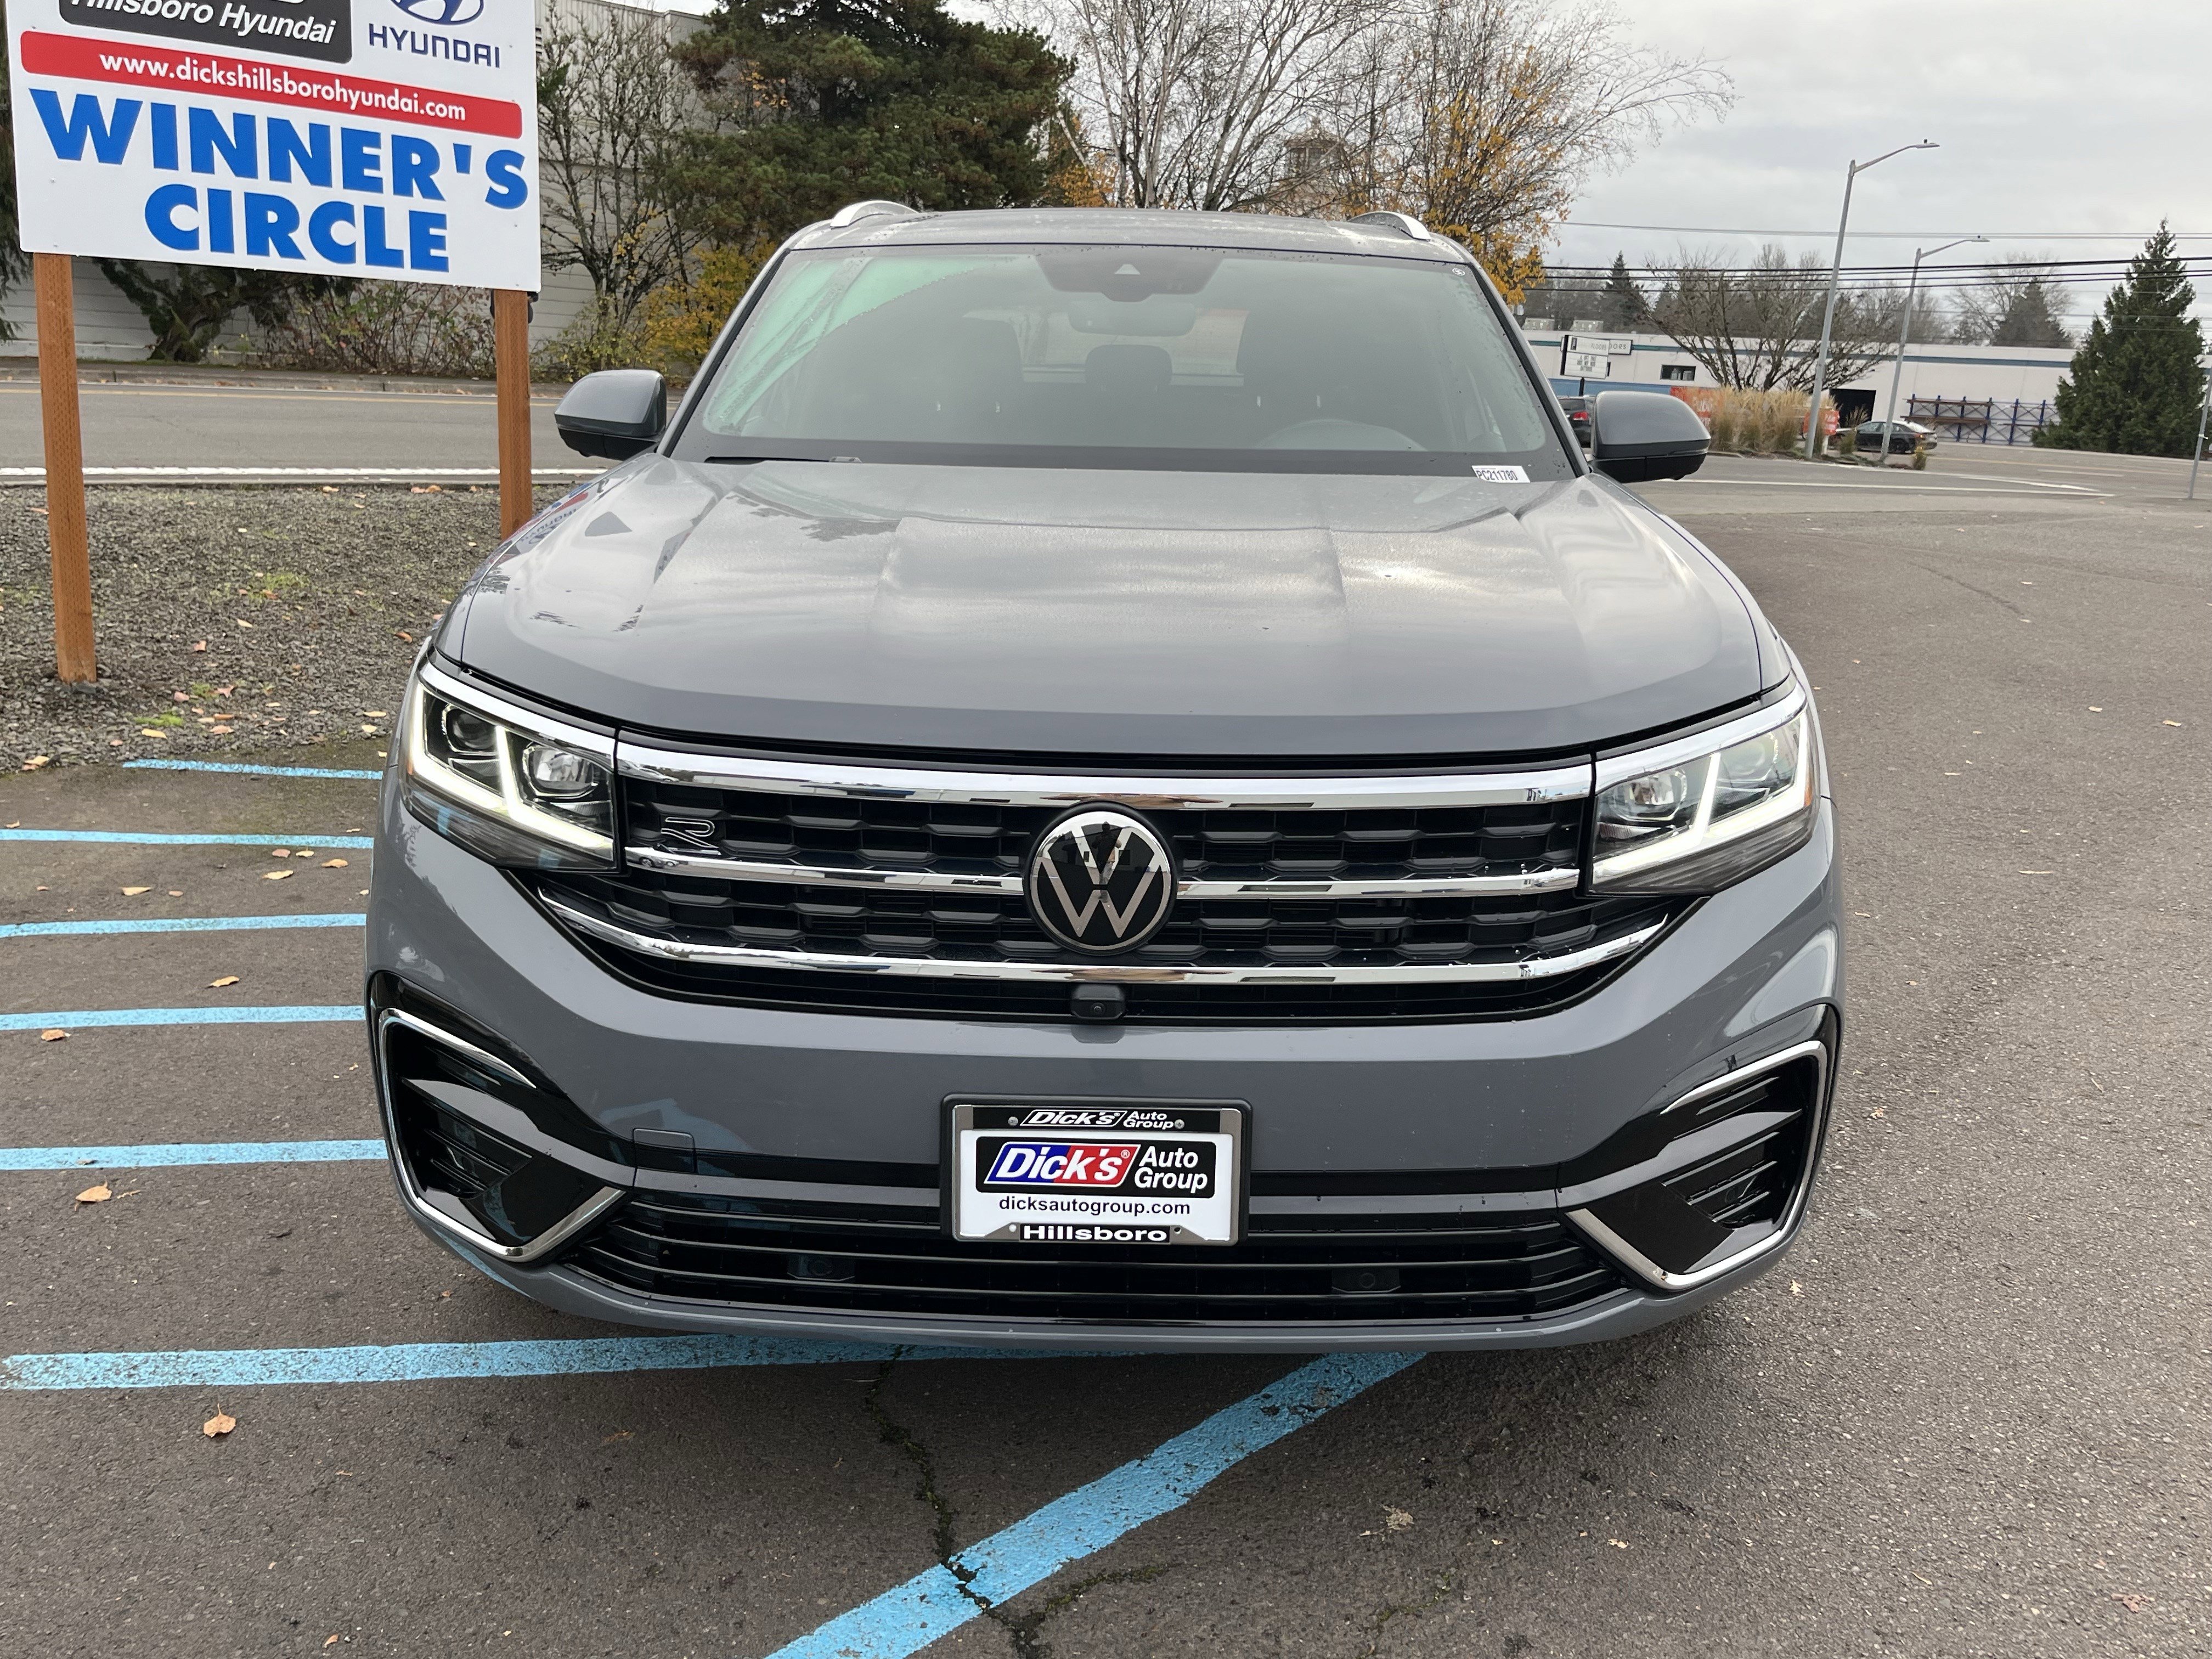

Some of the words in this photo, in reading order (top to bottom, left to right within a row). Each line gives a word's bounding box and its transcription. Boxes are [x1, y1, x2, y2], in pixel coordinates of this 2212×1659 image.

[71, 0, 214, 24] sboro
[219, 2, 336, 44] Hyundai
[369, 24, 501, 68] HYUNDAI
[99, 51, 466, 122] www.dickshillsborohyundai.com
[29, 88, 528, 210] WINNER'S
[144, 184, 449, 273] CIRCLE
[1475, 470, 1518, 481] PC211780
[1123, 1119, 1174, 1130] Group
[1126, 1111, 1167, 1120] Auto
[1139, 1146, 1198, 1169] Auto
[1134, 1166, 1208, 1194] Group
[999, 1196, 1190, 1216] dicksautogroup.com
[1023, 1226, 1167, 1242] Hillsboro
